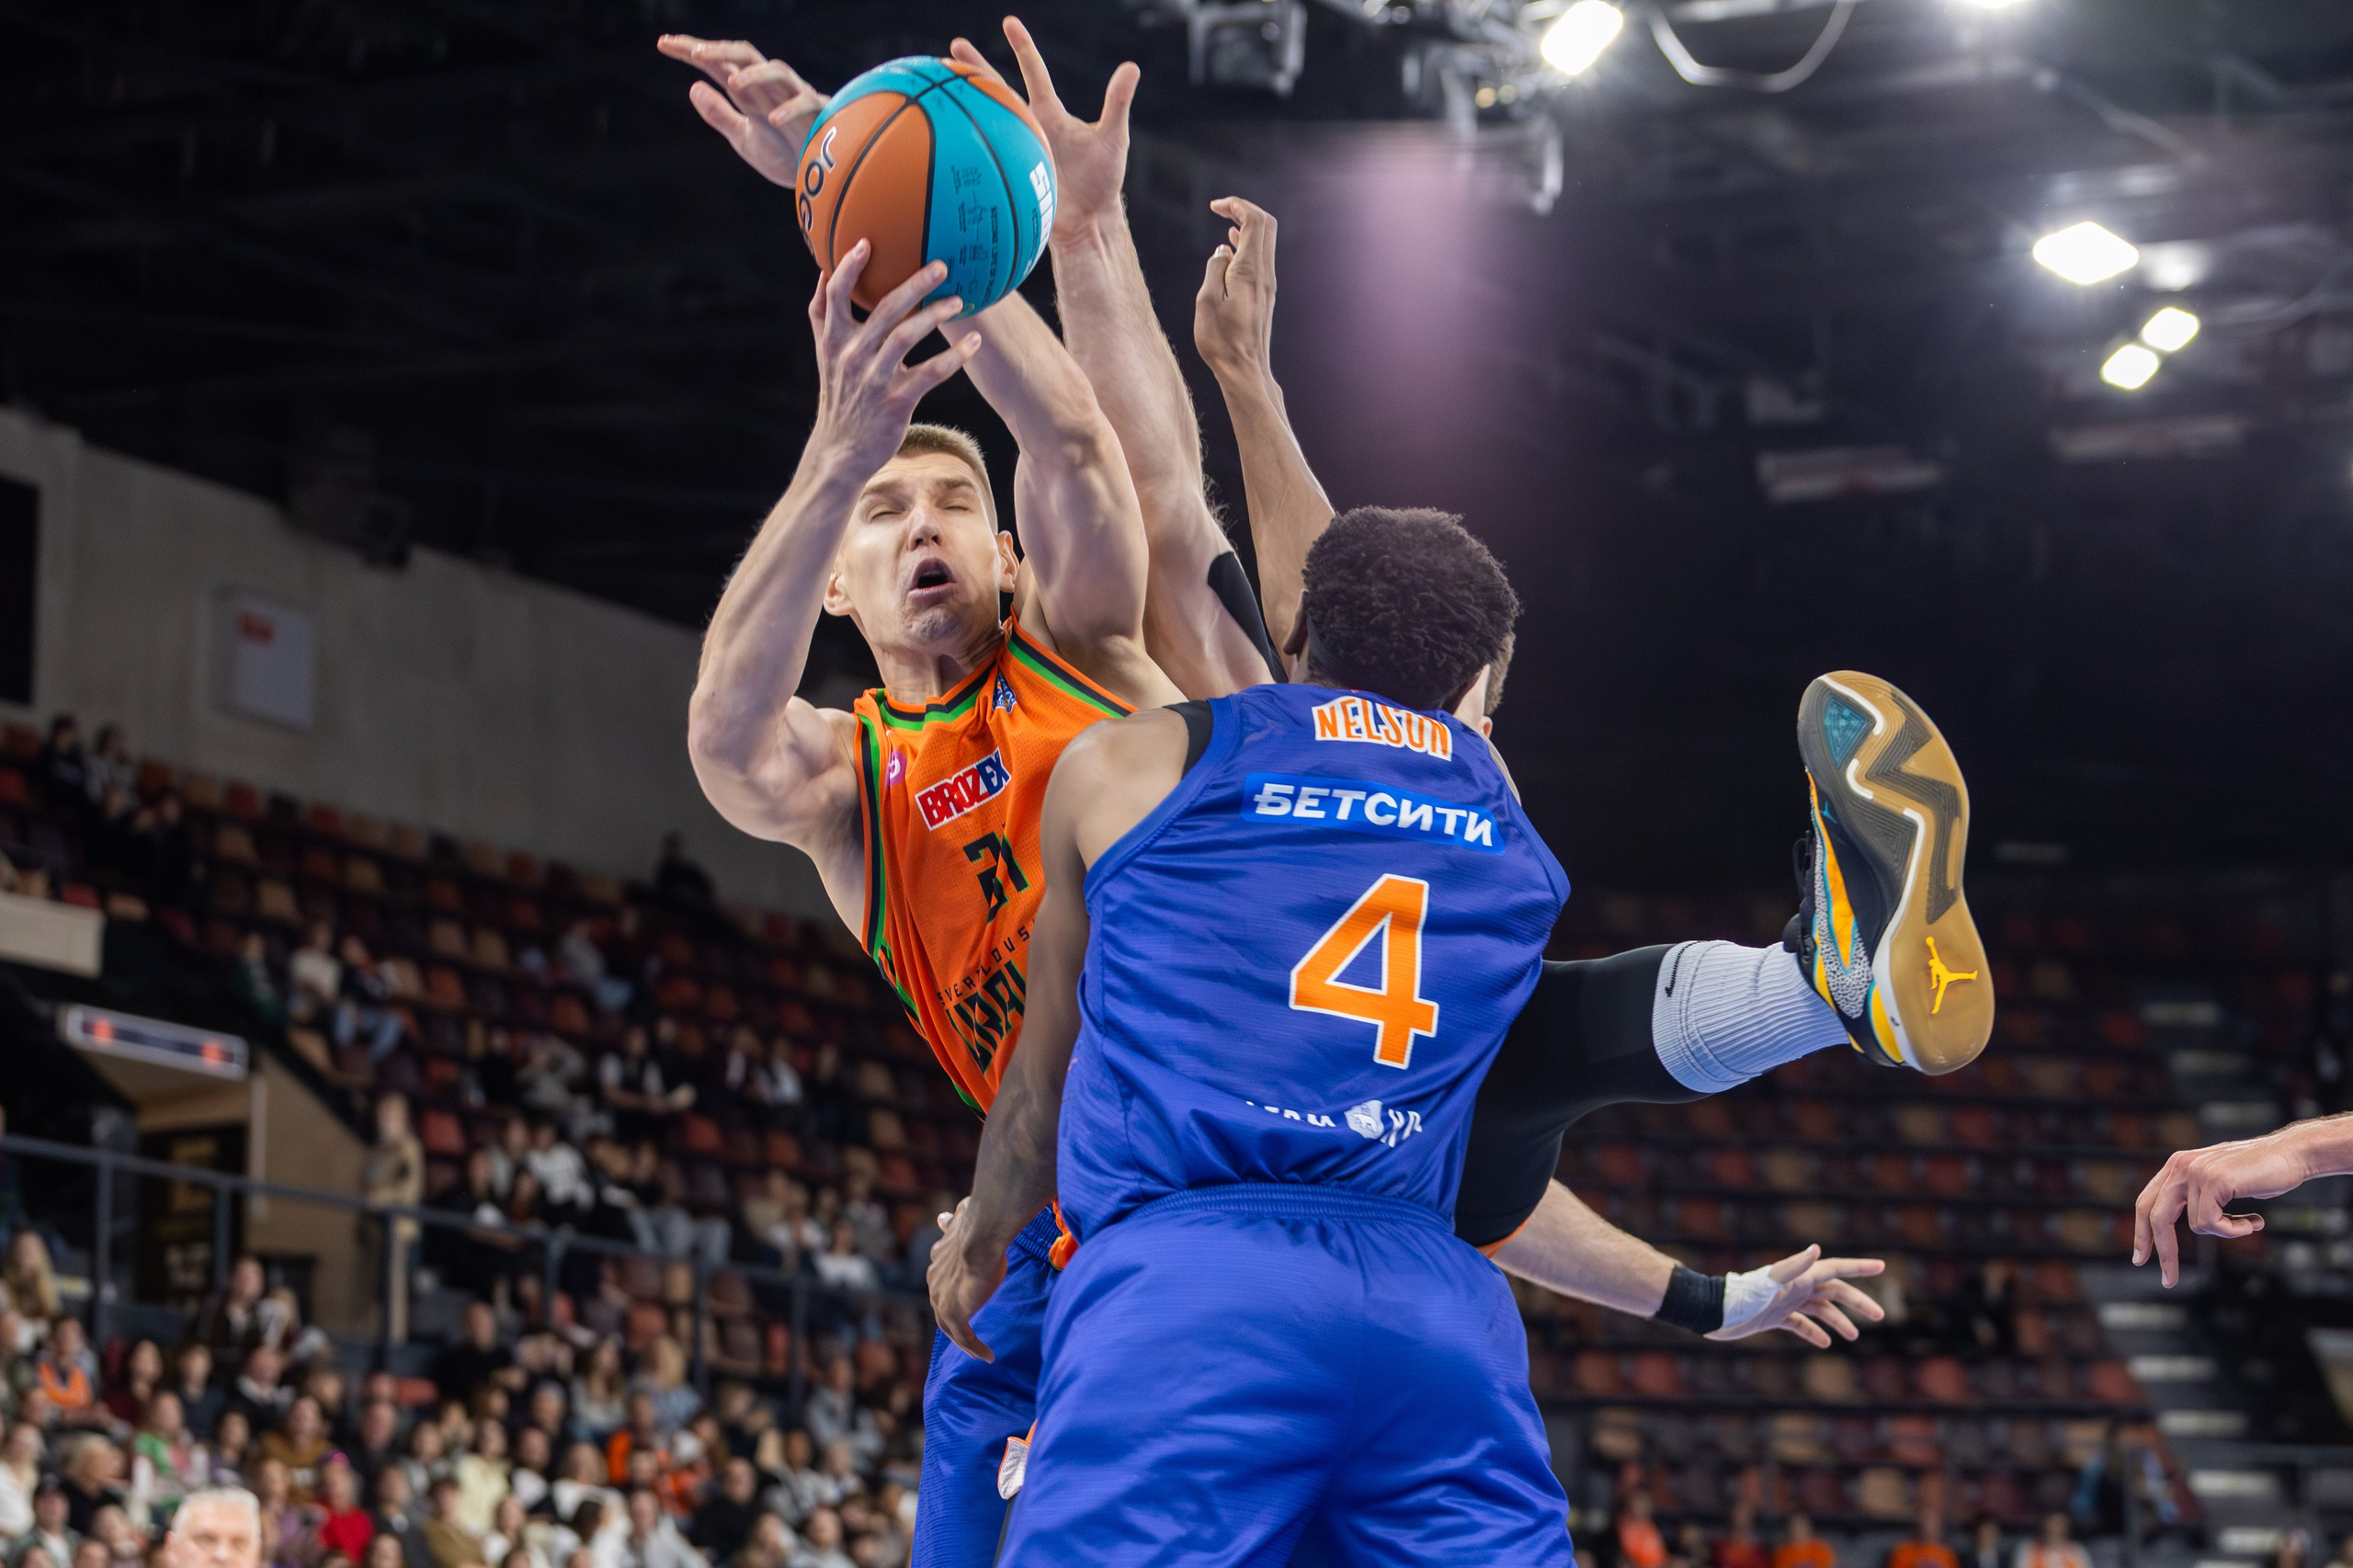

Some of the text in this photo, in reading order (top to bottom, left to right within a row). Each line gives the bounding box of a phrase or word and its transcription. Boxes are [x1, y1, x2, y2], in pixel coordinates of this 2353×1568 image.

[796, 125, 837, 255] JOG
[1311, 695, 1453, 762] NELSON
[917, 749, 1010, 828] BROZEX
[1252, 781, 1495, 847] БЕТСИТИ
[1290, 873, 1439, 1070] 4
